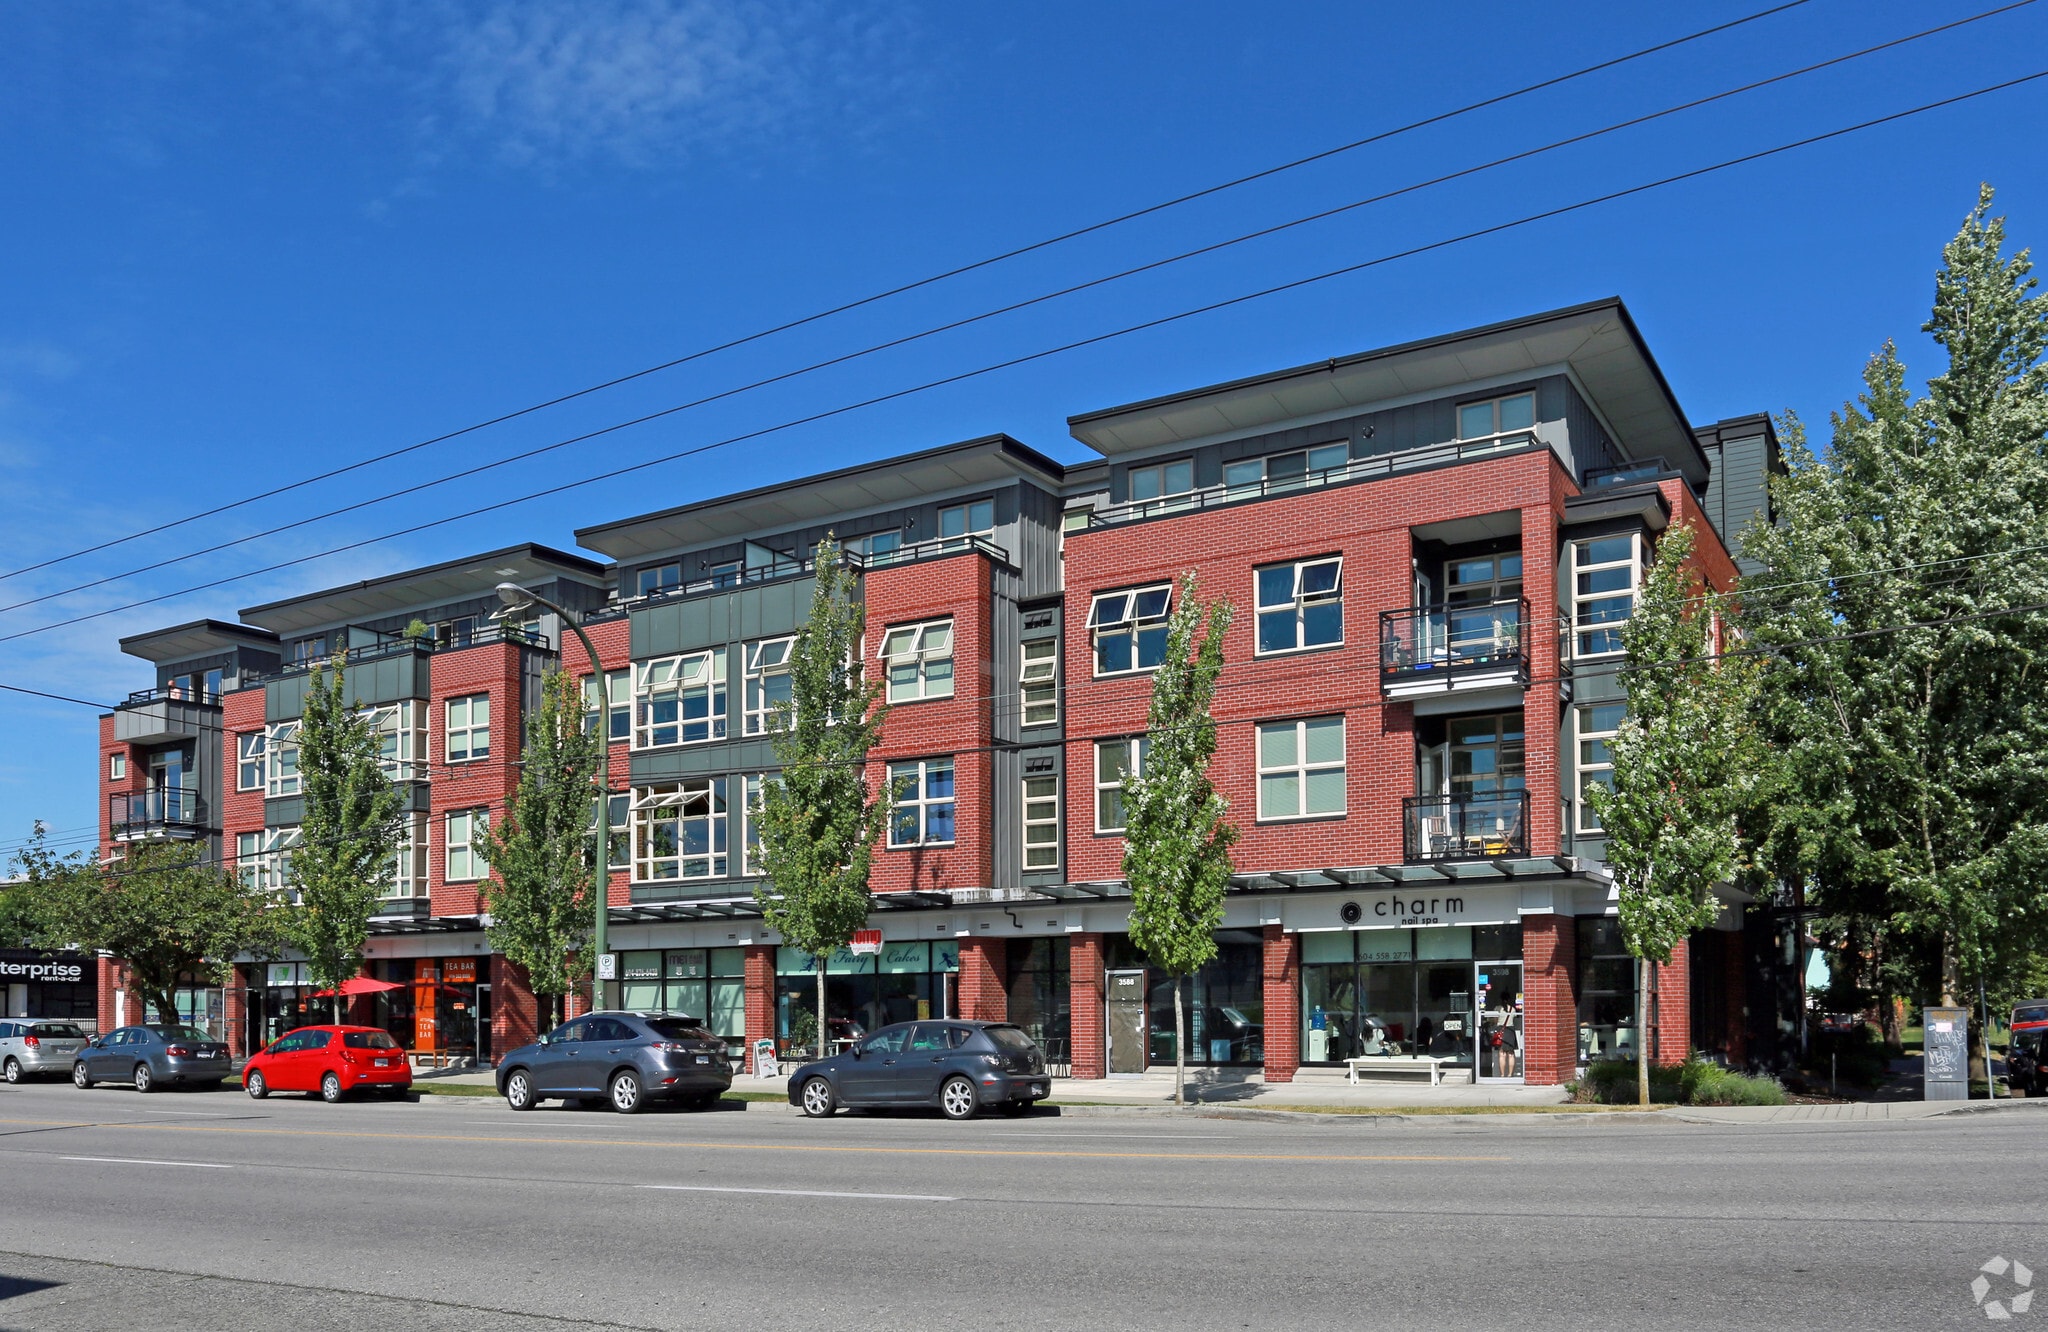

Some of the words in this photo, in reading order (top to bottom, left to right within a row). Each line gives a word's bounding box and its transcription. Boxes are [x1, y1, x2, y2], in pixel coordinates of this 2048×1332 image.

[1375, 895, 1464, 917] charm
[1401, 916, 1418, 926] nail
[1422, 917, 1438, 927] spa
[834, 949, 869, 973] Fairy
[886, 944, 920, 964] Cakes
[445, 962, 458, 971] TEA
[461, 962, 475, 970] BAR
[1444, 1022, 1462, 1030] OPEN
[419, 1031, 432, 1039] BAR
